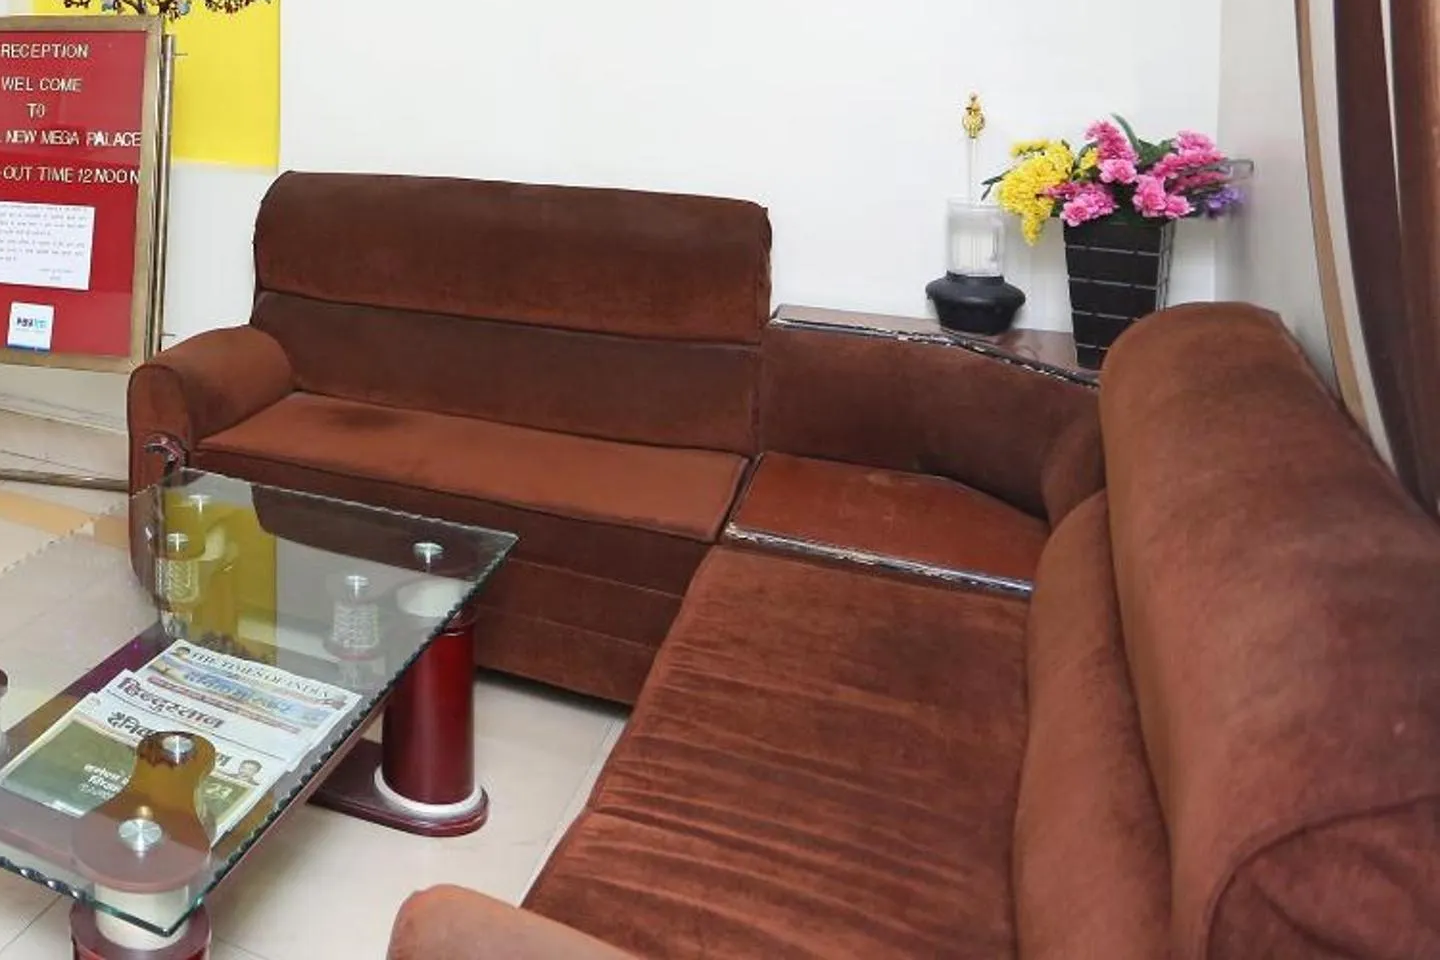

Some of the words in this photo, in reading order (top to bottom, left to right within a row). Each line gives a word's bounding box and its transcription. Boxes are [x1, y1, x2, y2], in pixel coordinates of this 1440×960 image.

[0, 43, 89, 59] RECEPTION
[27, 103, 46, 118] TO
[5, 130, 37, 144] NEW
[40, 130, 80, 146] MEGA
[86, 131, 142, 147] PALACE
[37, 166, 74, 184] TIME
